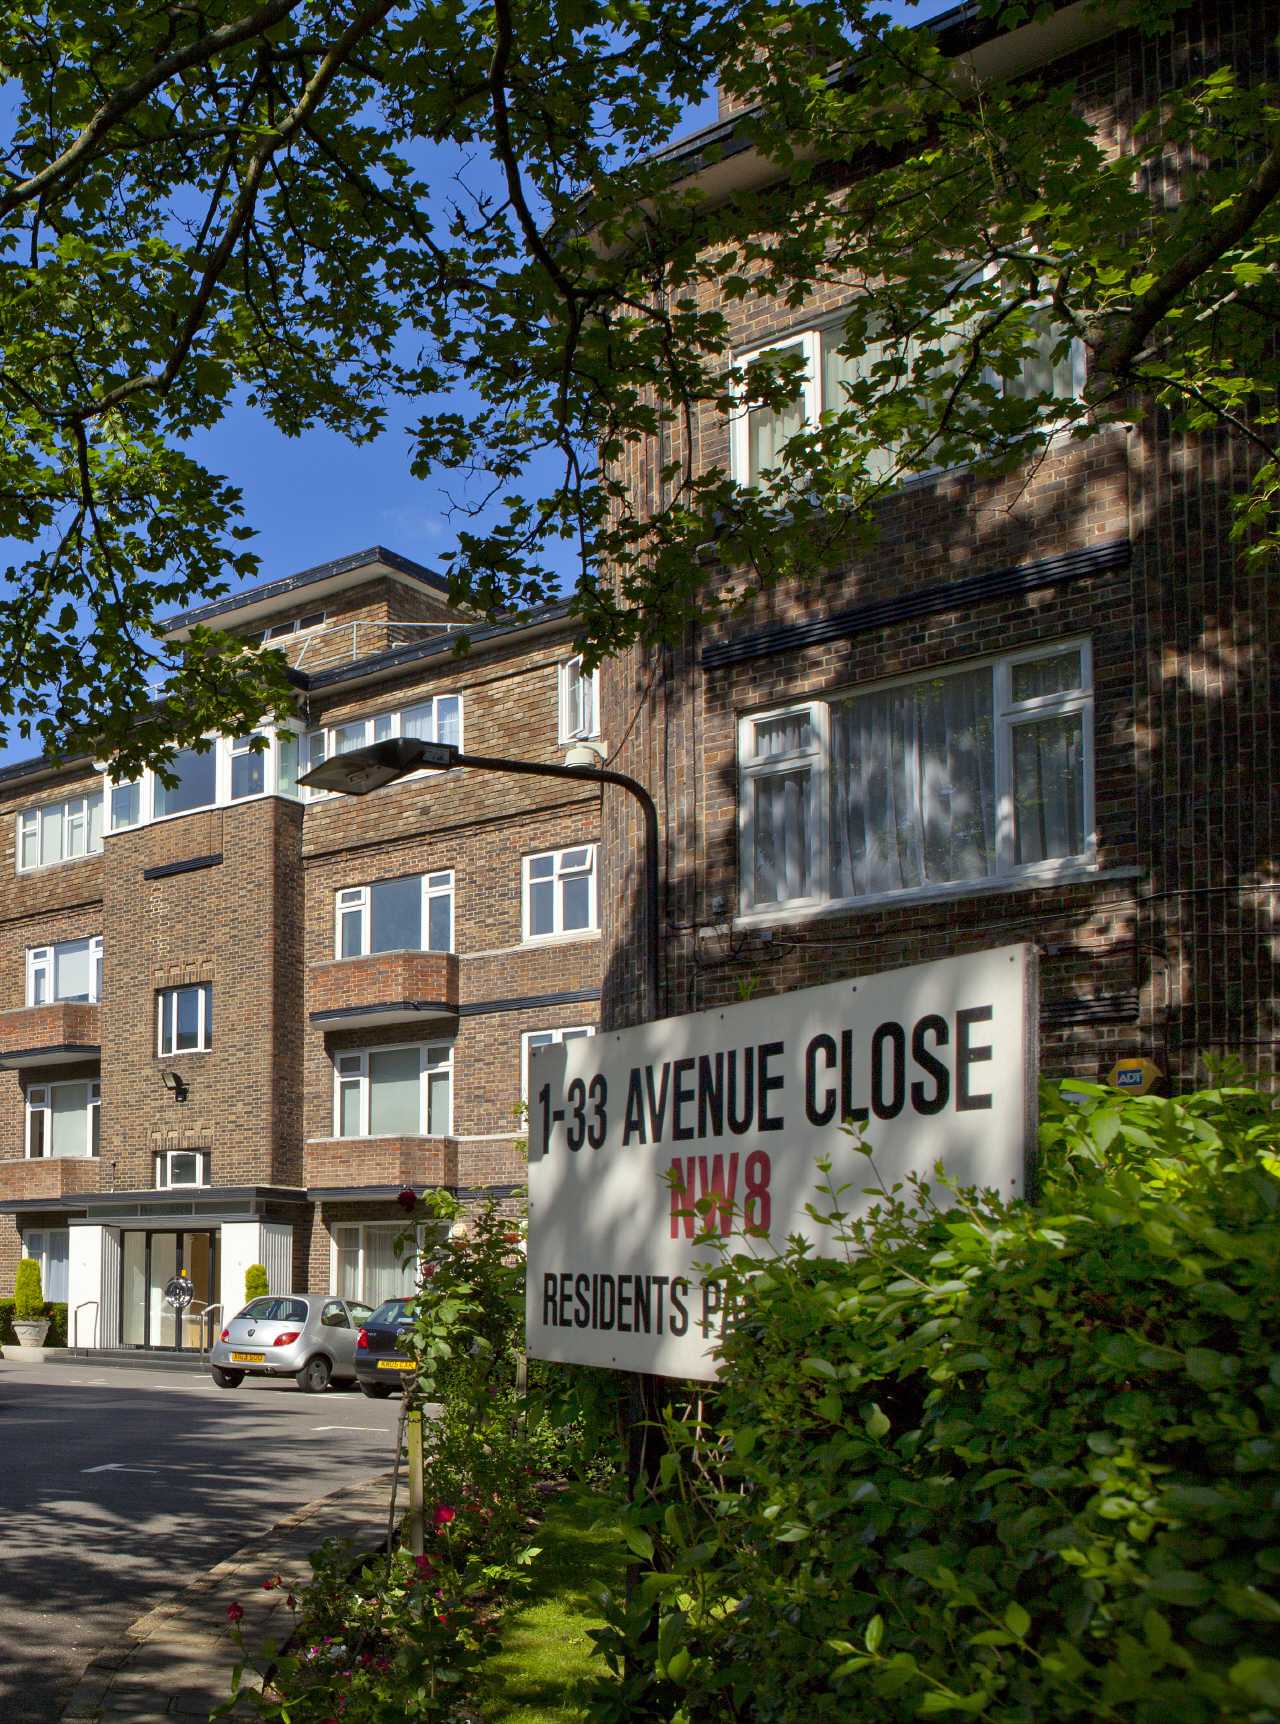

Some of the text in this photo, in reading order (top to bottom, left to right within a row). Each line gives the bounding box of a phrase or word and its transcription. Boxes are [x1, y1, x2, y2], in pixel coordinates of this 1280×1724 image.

[538, 1004, 994, 1155] 1-33 AVENUE CLOSE
[670, 1150, 771, 1240] NW8
[542, 1272, 689, 1337] RESIDENTS
